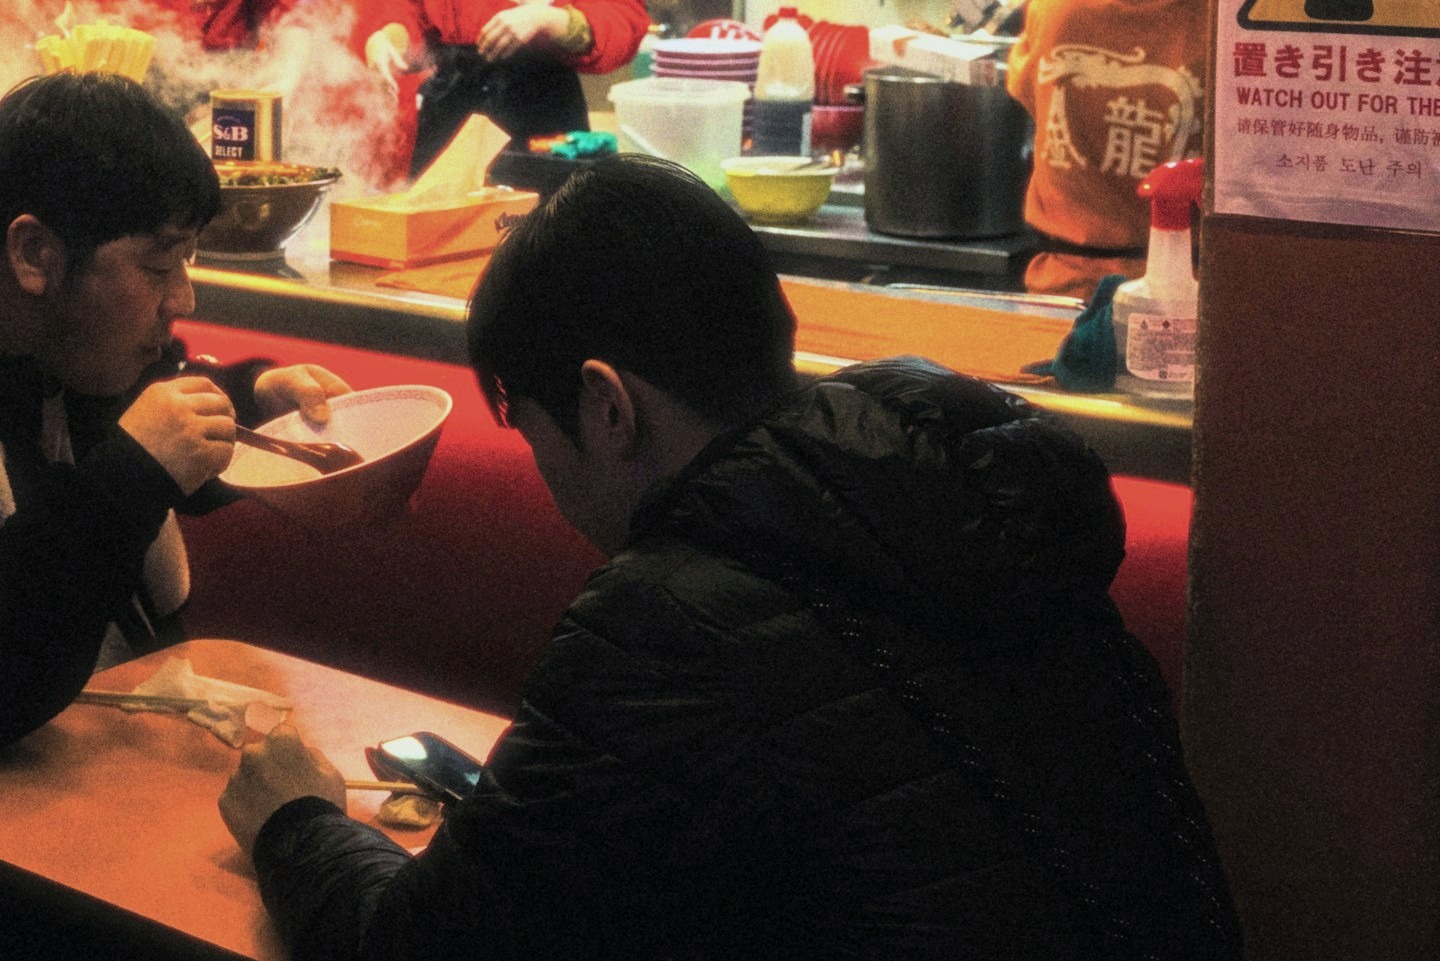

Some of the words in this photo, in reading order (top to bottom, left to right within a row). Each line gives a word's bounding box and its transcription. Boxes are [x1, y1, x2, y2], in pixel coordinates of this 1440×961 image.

[1233, 42, 1440, 86] 置き引き注
[1237, 87, 1303, 109] WATCH
[1311, 90, 1350, 111] OUT
[1358, 94, 1398, 114] FOR
[213, 123, 248, 142] S&B
[1276, 153, 1329, 172] 소지품
[1339, 158, 1376, 176] 도난
[1386, 160, 1422, 179] 주의
